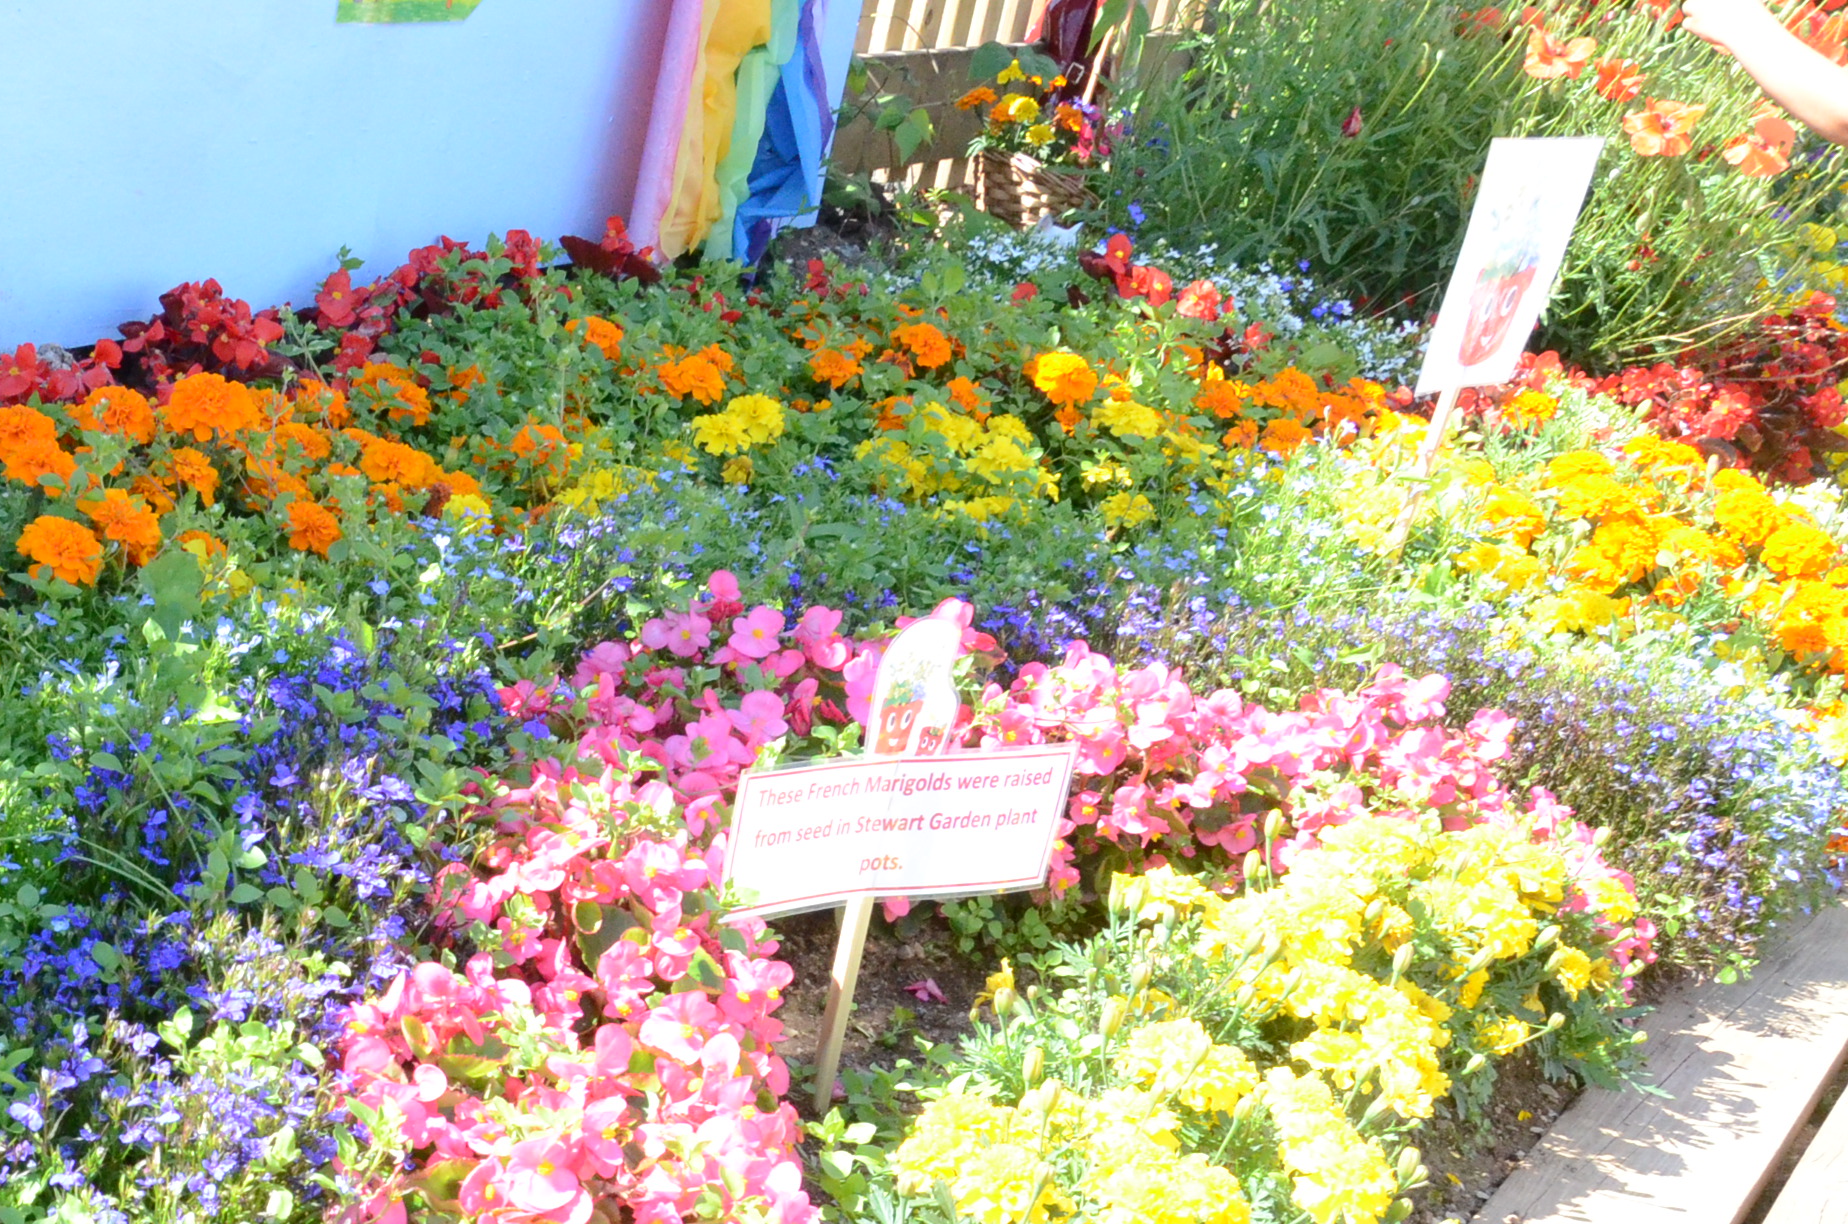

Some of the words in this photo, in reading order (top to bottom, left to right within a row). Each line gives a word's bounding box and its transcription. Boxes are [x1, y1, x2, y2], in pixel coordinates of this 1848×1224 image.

[758, 784, 803, 808] These
[807, 777, 860, 800] French
[864, 772, 952, 796] Marigolds
[957, 773, 1000, 790] were
[1003, 766, 1054, 787] raised
[754, 829, 791, 848] from
[795, 819, 832, 843] seed
[836, 819, 851, 837] in
[855, 814, 925, 834] Stewart
[929, 808, 991, 830] Garden
[995, 808, 1039, 831] plant
[859, 854, 903, 876] pots.
